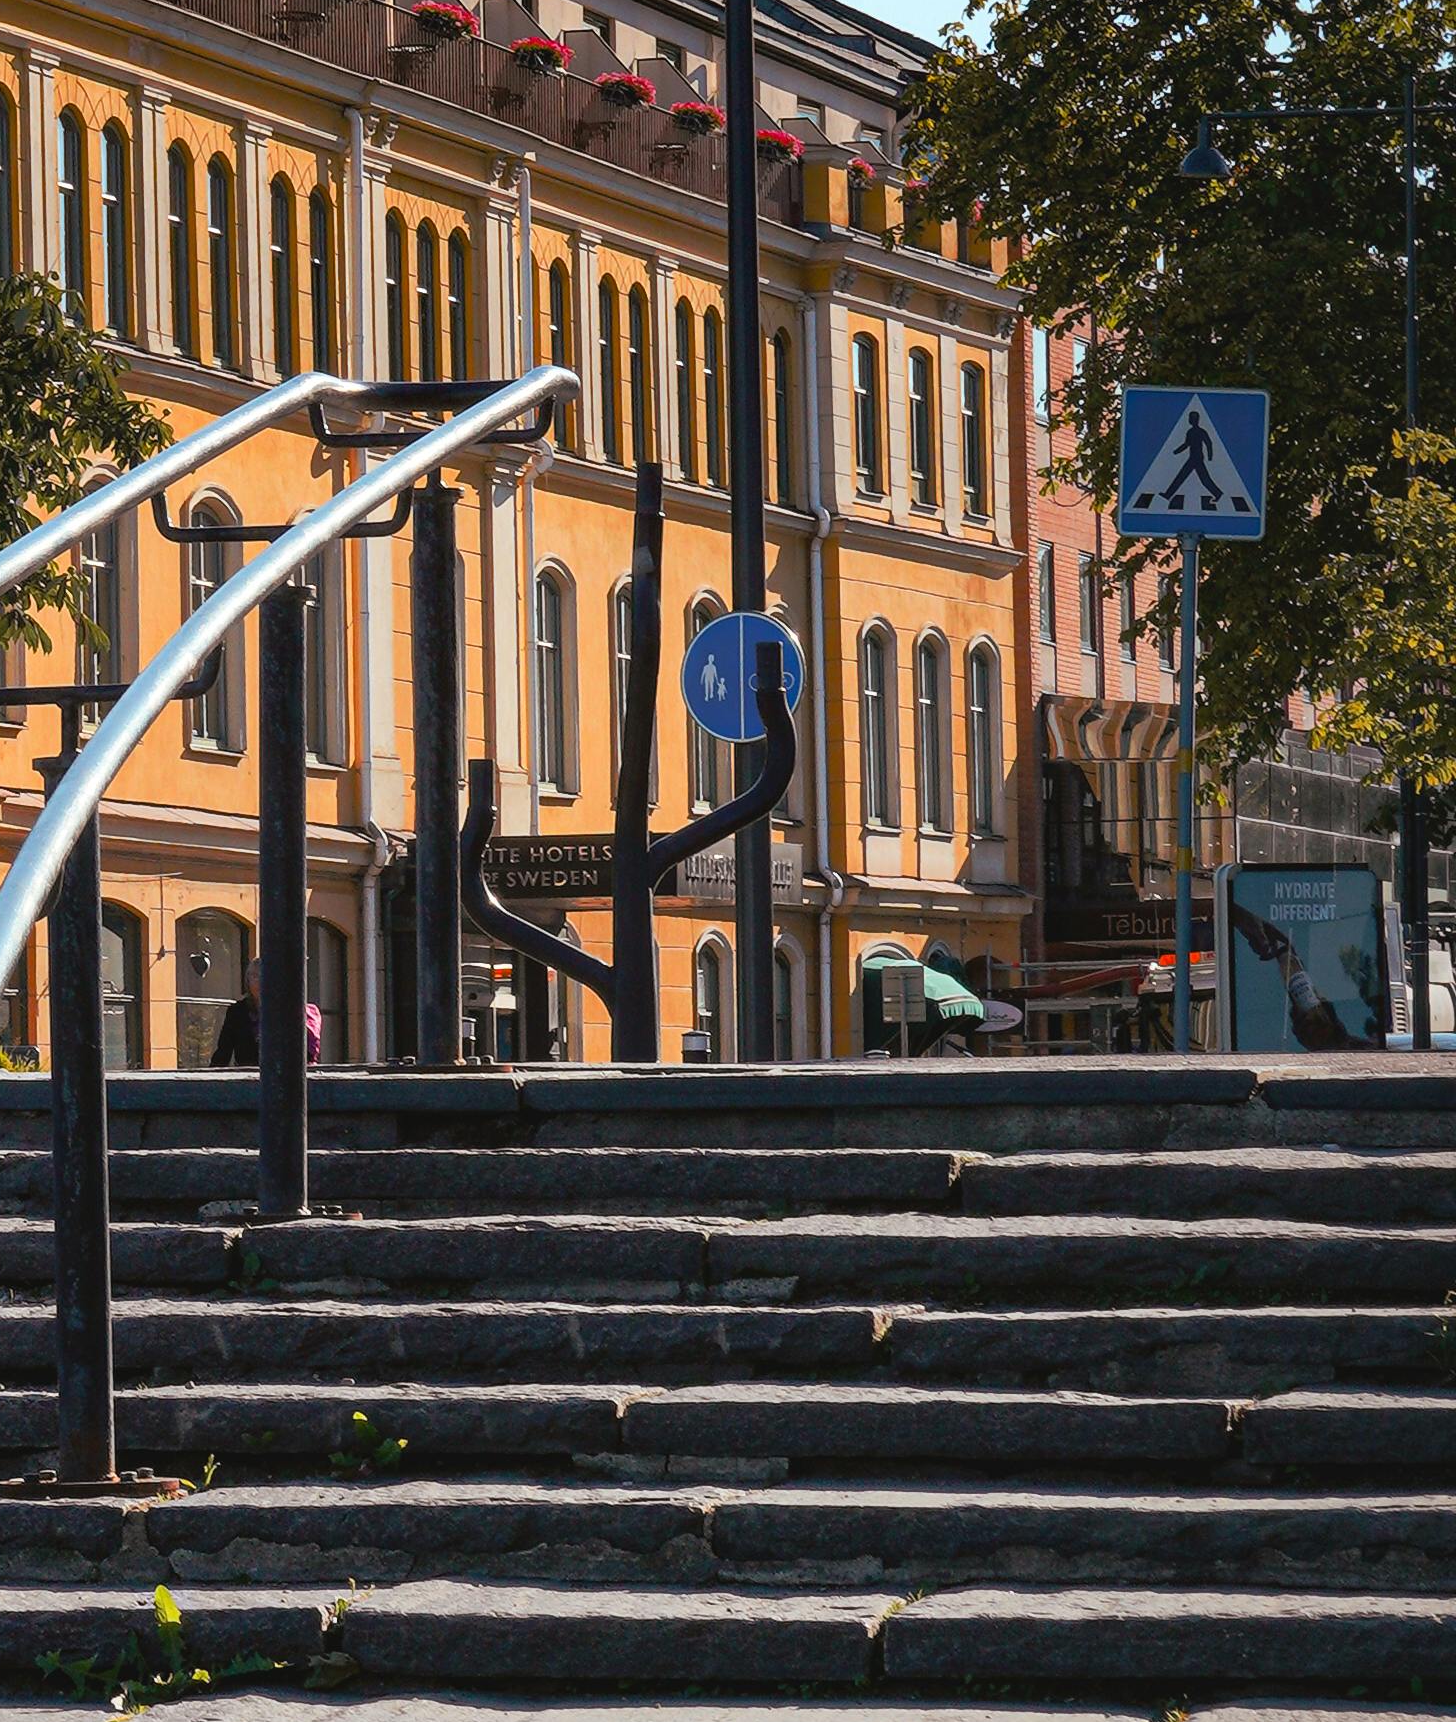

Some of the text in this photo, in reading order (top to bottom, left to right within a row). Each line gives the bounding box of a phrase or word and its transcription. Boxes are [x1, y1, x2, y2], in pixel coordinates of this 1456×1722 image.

[529, 845, 613, 864] HOTELS
[506, 870, 599, 888] SWEDEN
[1274, 881, 1335, 899] HYDRATE
